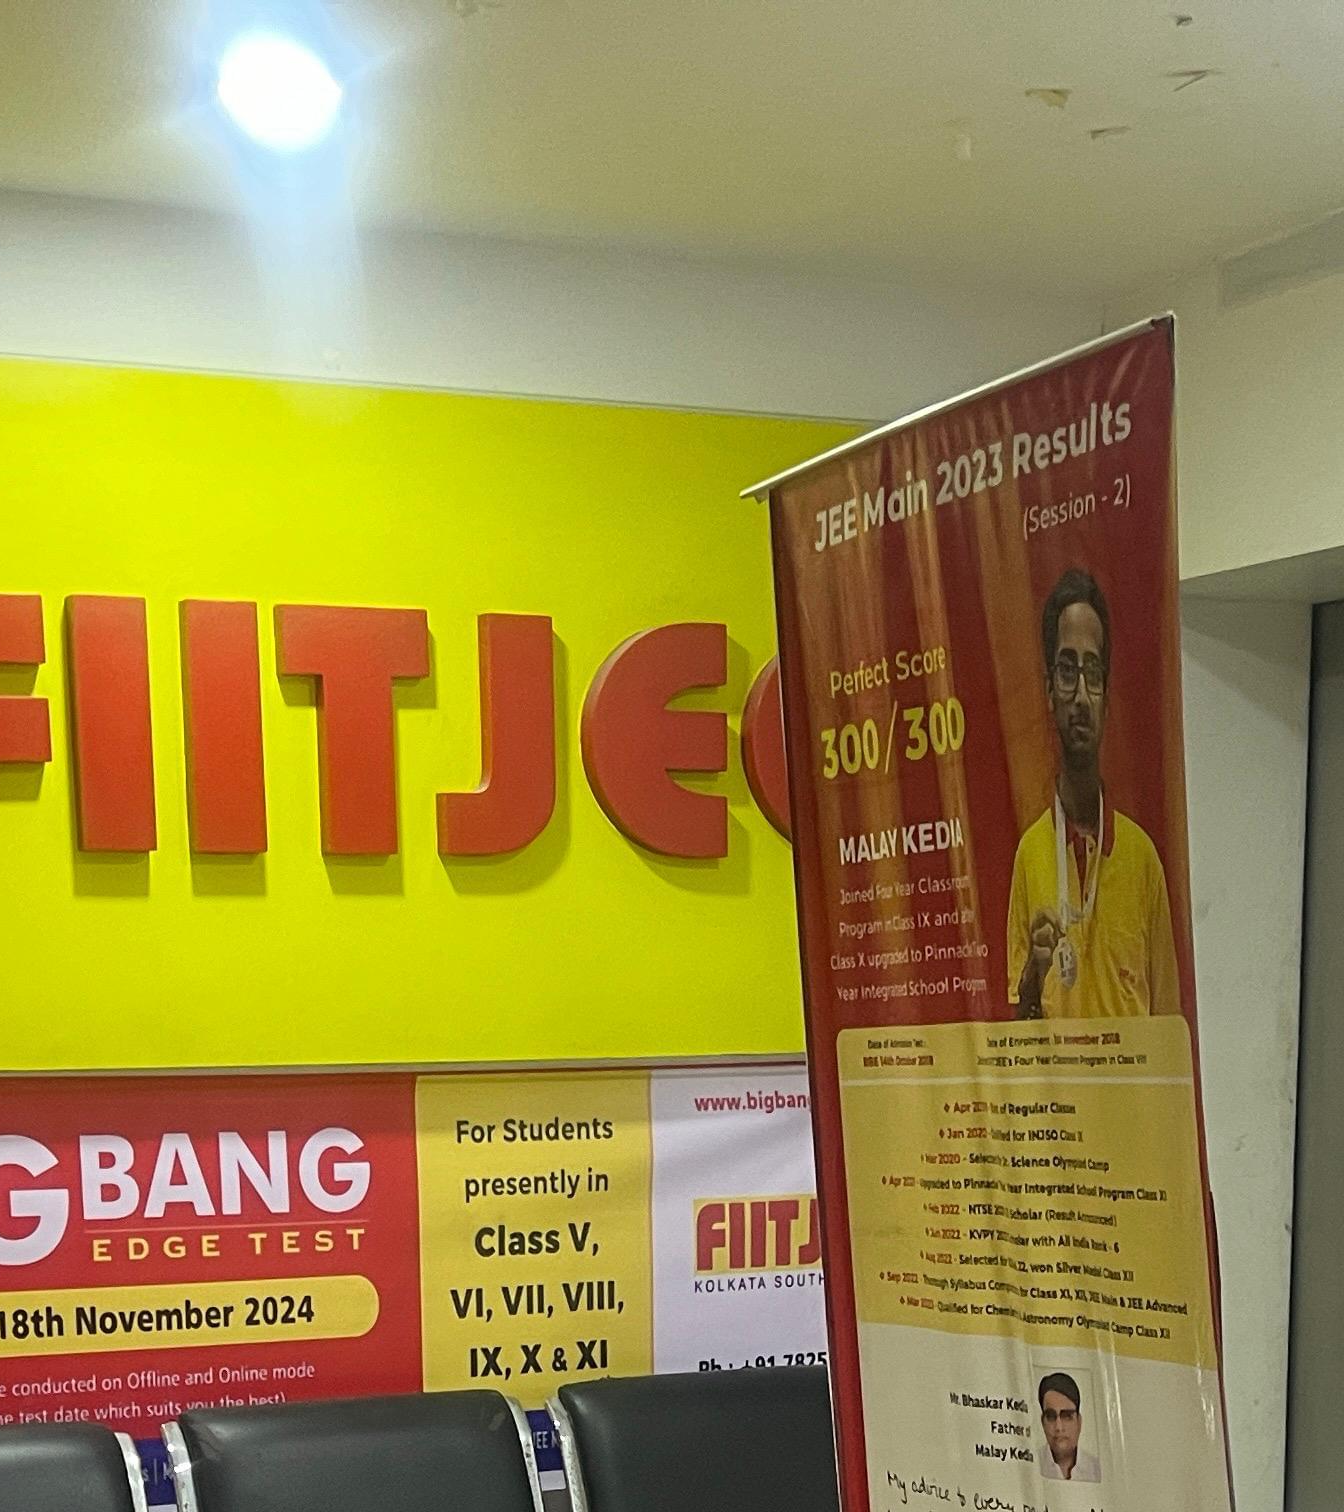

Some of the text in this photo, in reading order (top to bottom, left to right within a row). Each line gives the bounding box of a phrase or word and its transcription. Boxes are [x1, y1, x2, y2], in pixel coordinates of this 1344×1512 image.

[815, 400, 1131, 552] JEE Main 2023 Results
[1023, 472, 1130, 541] (Session 2)
[830, 645, 946, 699] Perfect Score
[821, 697, 965, 780] 300 / 300
[839, 817, 964, 865] MALAY KEDIA
[840, 884, 874, 905] Joined
[839, 919, 882, 939] Program
[918, 912, 930, 928] IX
[935, 906, 958, 926] and
[830, 954, 855, 970] Class
[858, 953, 865, 967] X
[911, 949, 922, 964] to
[837, 987, 858, 1001] Year
[909, 976, 949, 997] School
[694, 1090, 811, 1114] www.bigban
[456, 1117, 613, 1145] For Students
[78, 1127, 371, 1221] BANG
[465, 1168, 609, 1203] presently in
[93, 1228, 367, 1263] EDGE TEST
[474, 1222, 599, 1257] Class V,
[1031, 1234, 1055, 1247] with
[694, 1275, 766, 1293] KOLKATA
[1031, 1264, 1053, 1274] won
[75, 1300, 234, 1335] November
[244, 1295, 315, 1328] 2024
[450, 1281, 624, 1322] VI, VII, VIII,
[469, 1340, 608, 1380] IX, X & XI
[11, 1377, 96, 1397] conducted
[101, 1377, 123, 1391] on
[127, 1371, 180, 1391] Offline
[184, 1368, 213, 1386] and
[217, 1366, 268, 1385] Online
[272, 1362, 315, 1380] mode
[53, 1405, 90, 1422] date
[94, 1401, 141, 1420] which
[146, 1400, 182, 1417] suits
[962, 1394, 1003, 1410] Bhaskar
[991, 1421, 1023, 1436] Father
[975, 1444, 1007, 1461] Malay
